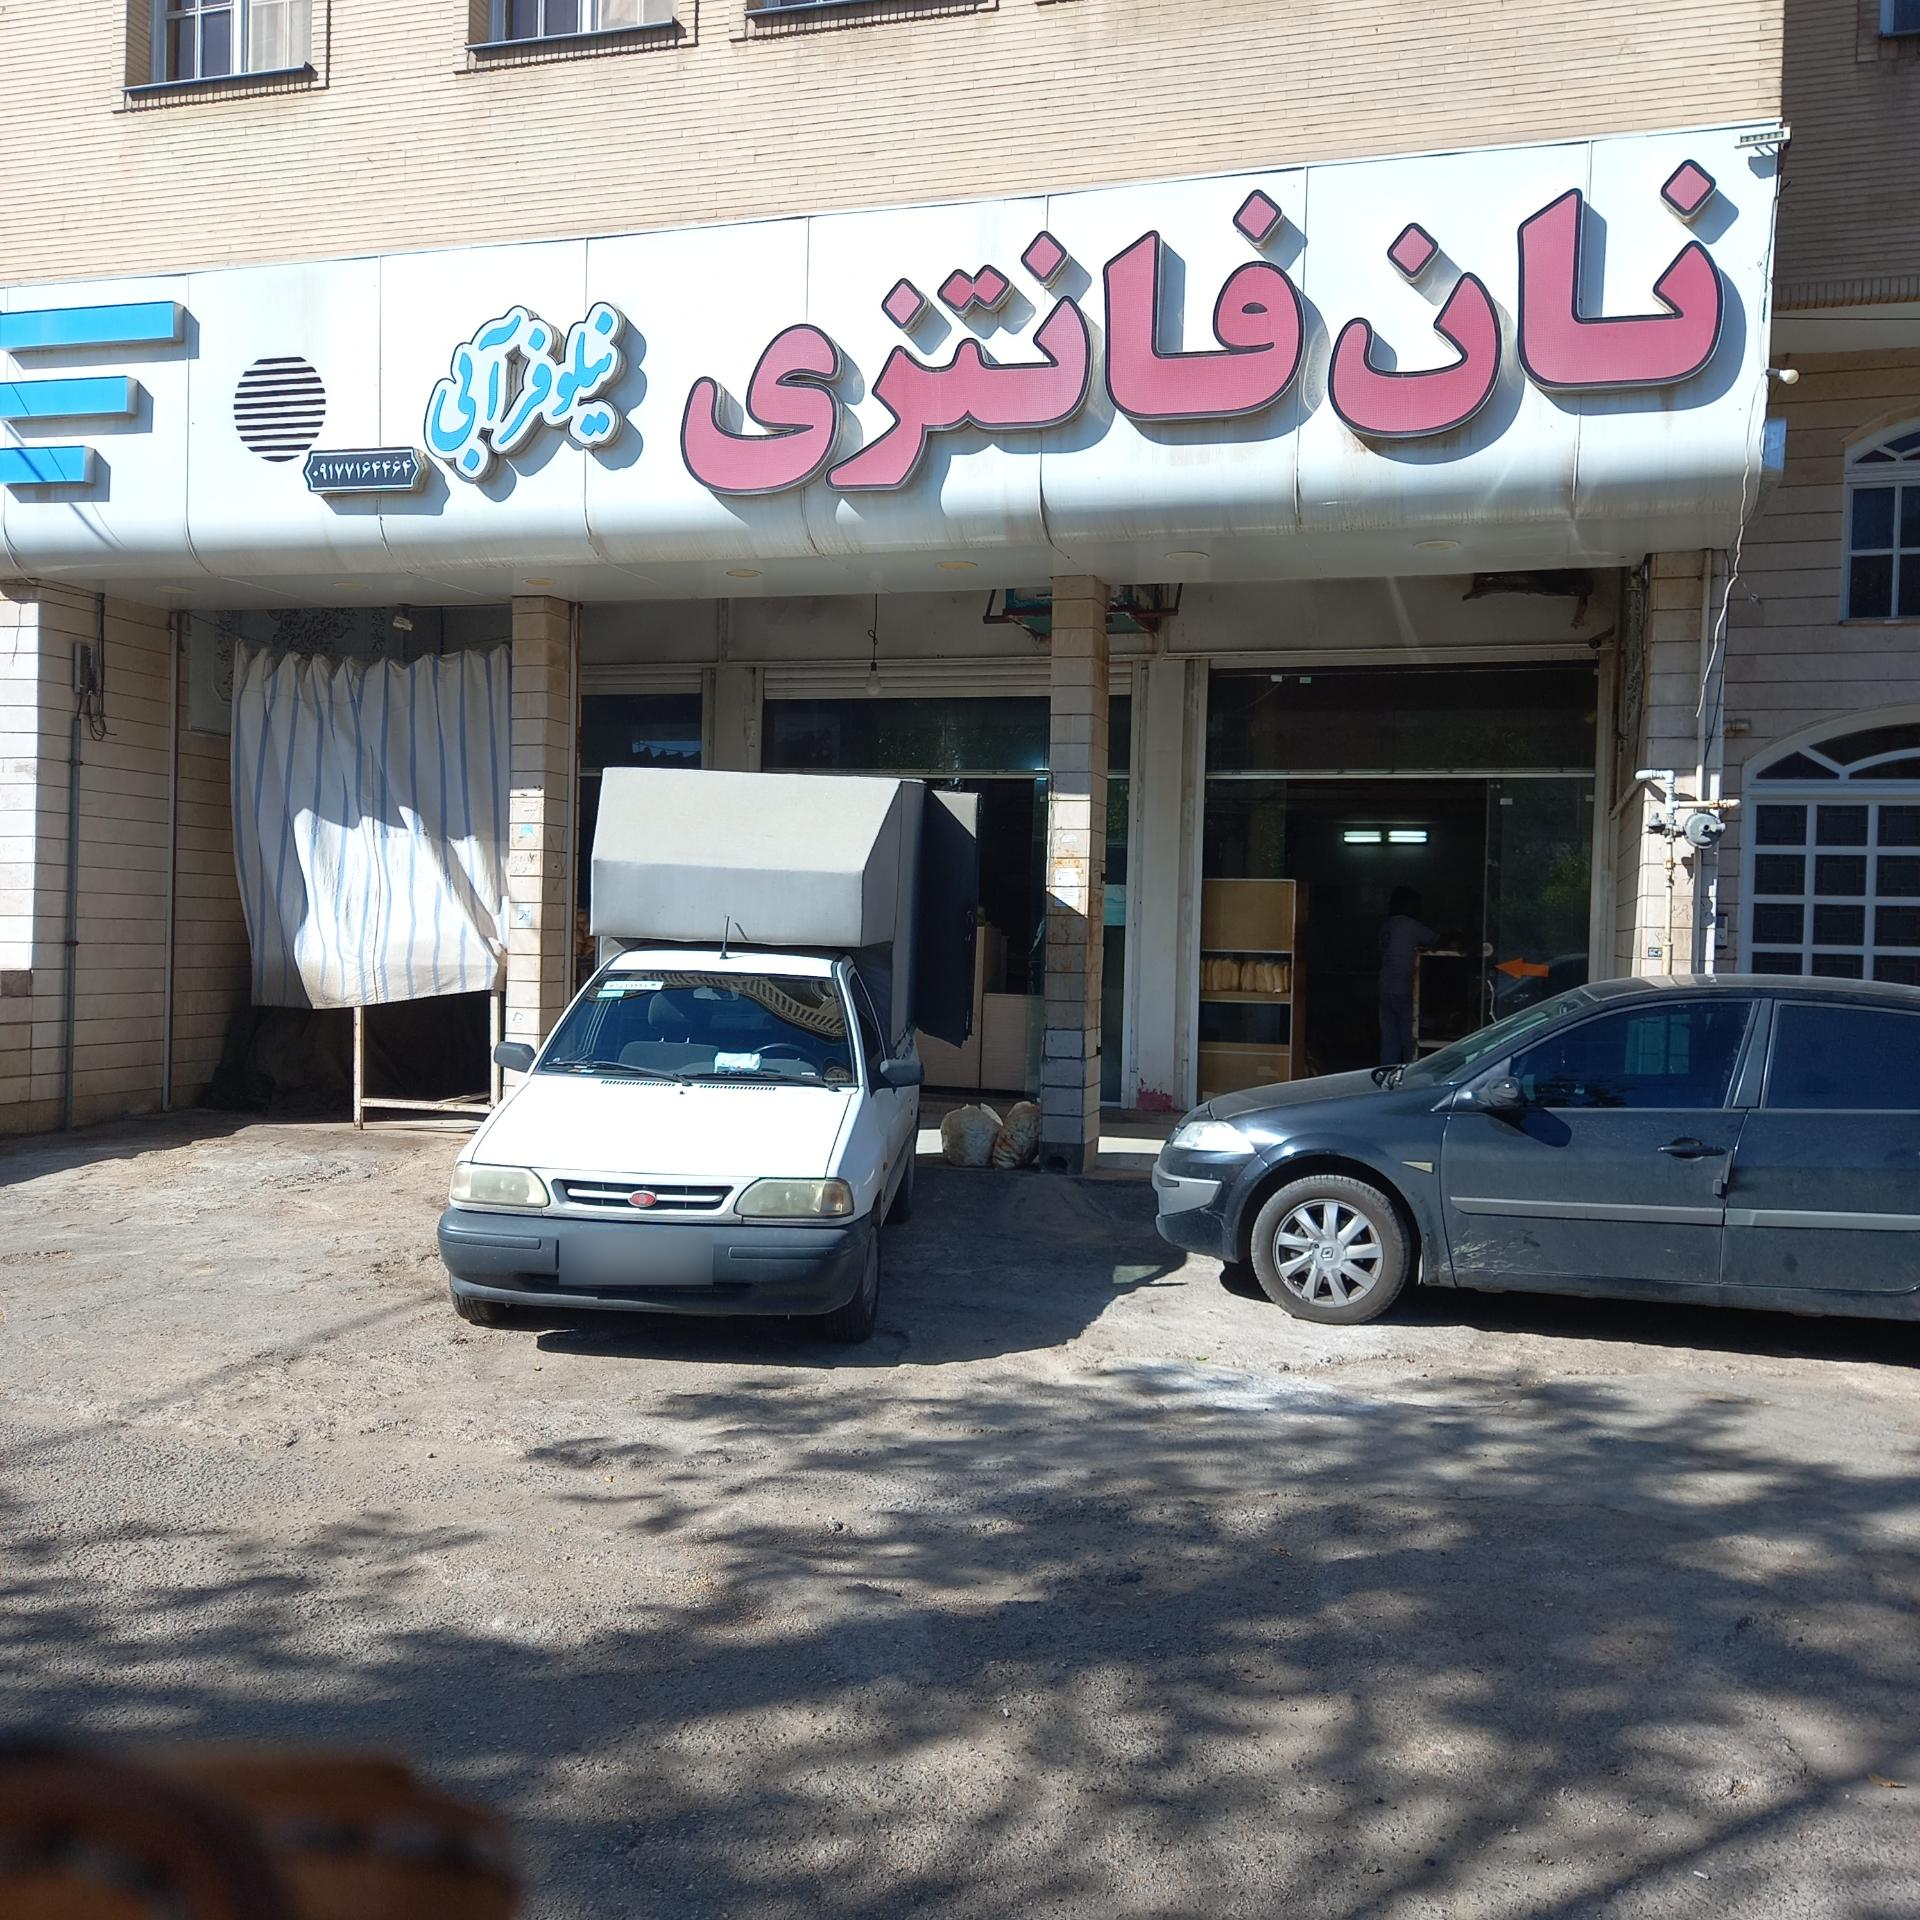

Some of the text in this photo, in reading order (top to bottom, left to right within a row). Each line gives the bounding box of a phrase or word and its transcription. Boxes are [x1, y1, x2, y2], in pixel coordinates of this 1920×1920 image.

[428, 307, 617, 473] نیلوفر آبی
[680, 158, 1726, 494] نان فانتزی
[312, 459, 412, 480] ۰۹۱۷۷۱۶۴۴۶۴
